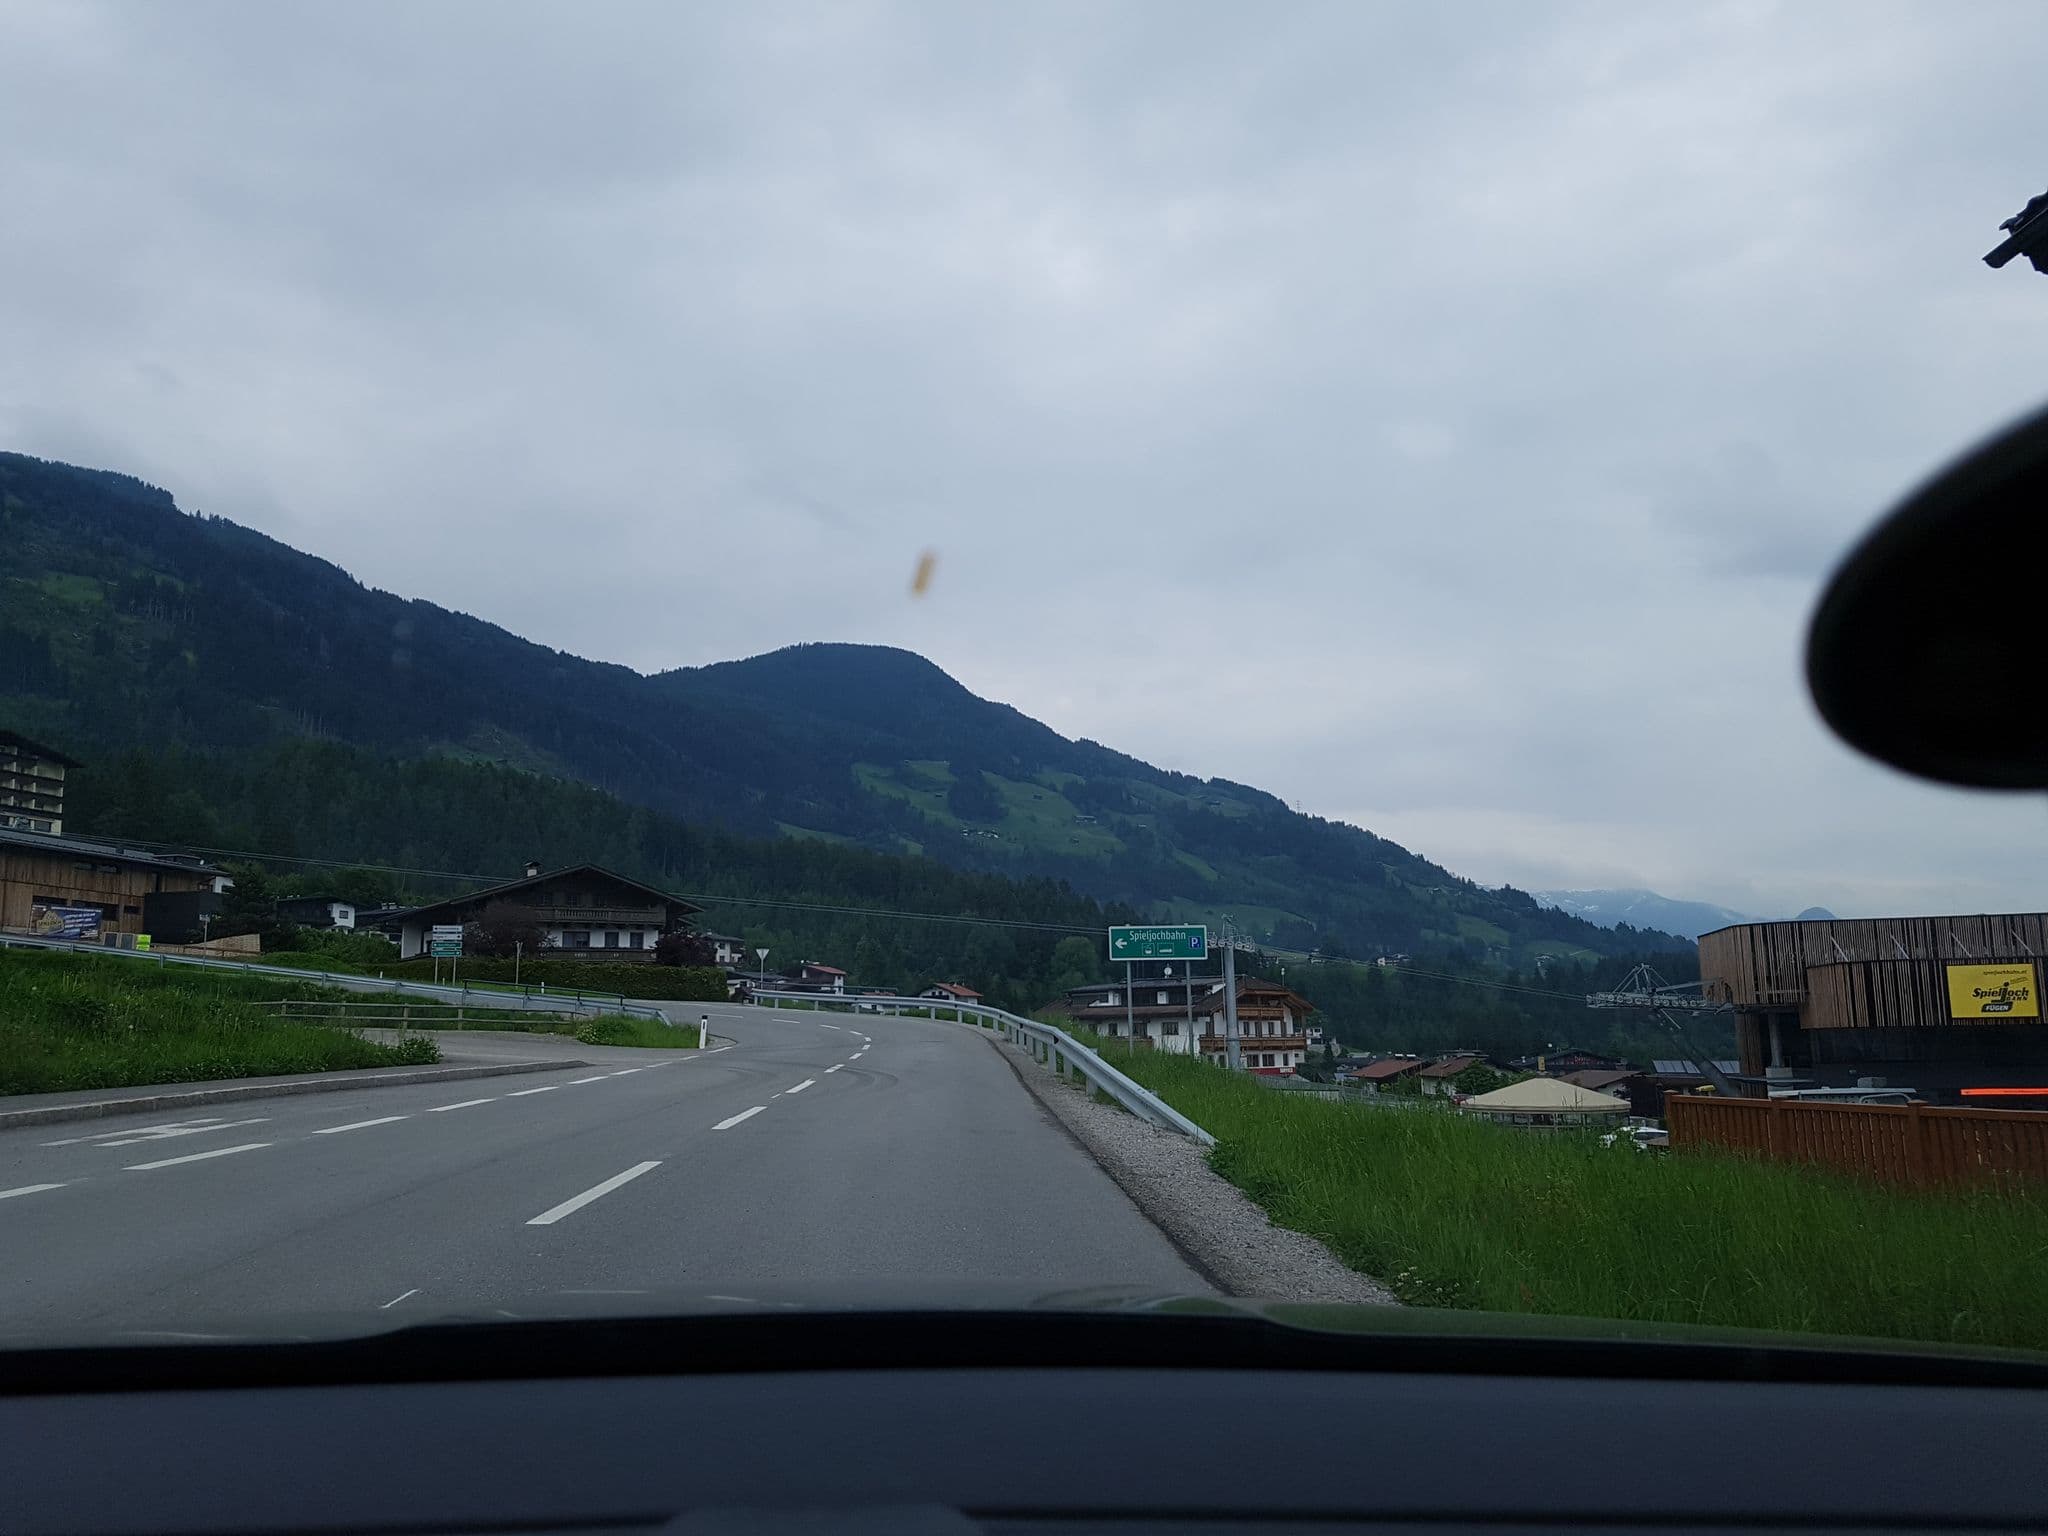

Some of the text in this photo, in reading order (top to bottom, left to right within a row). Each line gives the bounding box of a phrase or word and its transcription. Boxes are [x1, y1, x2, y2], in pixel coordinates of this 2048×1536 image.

[1129, 930, 1186, 942] Spieljochbahn
[1192, 937, 1199, 947] P
[1972, 982, 2029, 1002] Spieljoch
